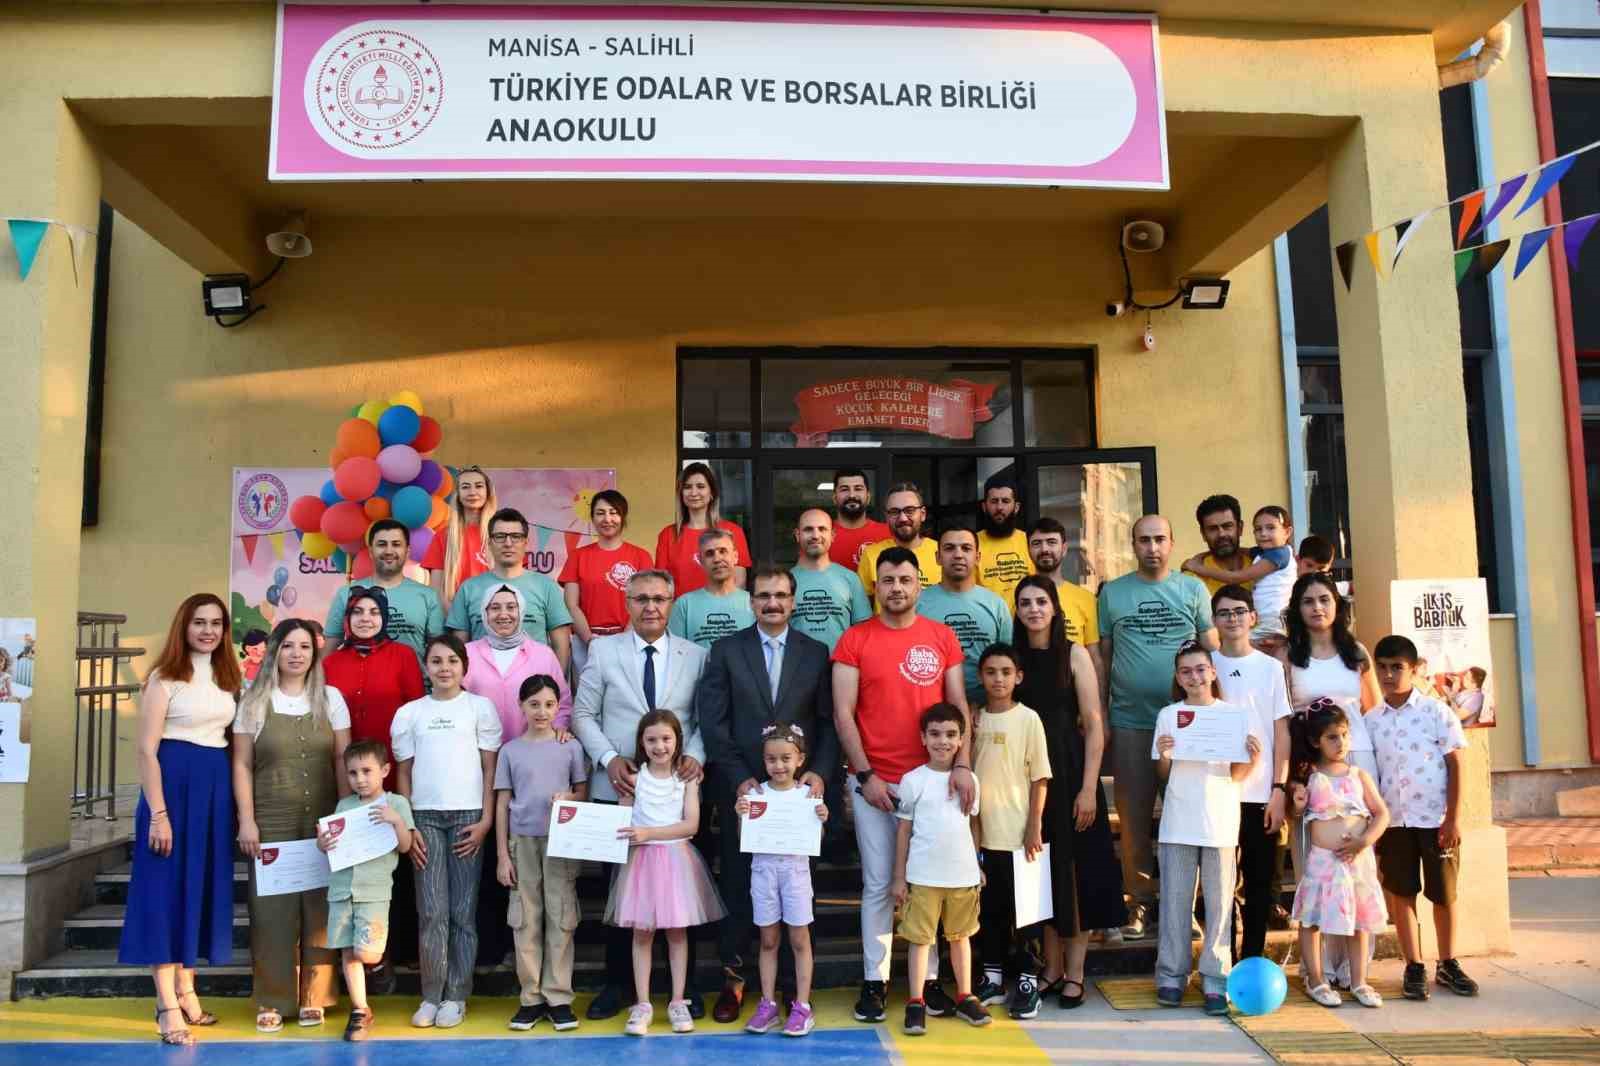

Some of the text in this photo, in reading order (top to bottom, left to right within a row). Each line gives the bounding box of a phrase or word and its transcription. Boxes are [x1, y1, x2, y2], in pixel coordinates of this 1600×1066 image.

[488, 37, 580, 57] MANİSA
[605, 33, 694, 57] SALİHLİ
[489, 72, 1036, 110] TÜRKİYE ODALAR VE BORSALAR BİRLİĞİ
[486, 117, 656, 143] ANAOKULU
[813, 380, 861, 398] SADECE
[848, 415, 896, 426] EMANET
